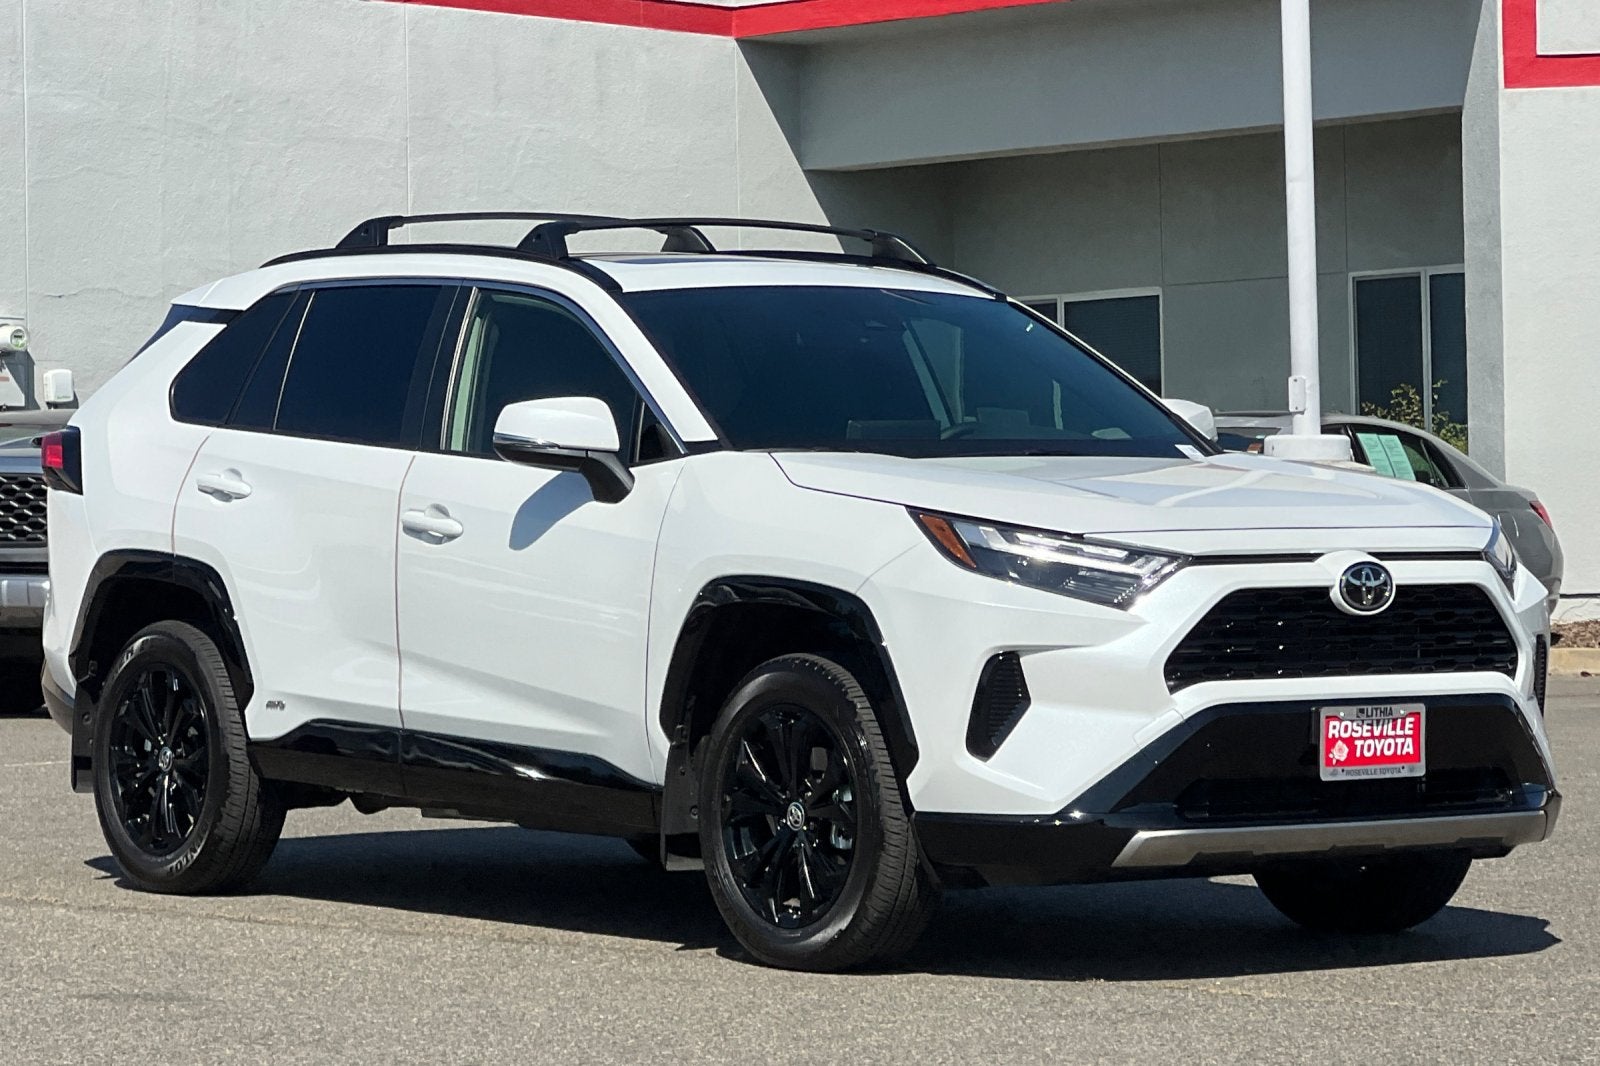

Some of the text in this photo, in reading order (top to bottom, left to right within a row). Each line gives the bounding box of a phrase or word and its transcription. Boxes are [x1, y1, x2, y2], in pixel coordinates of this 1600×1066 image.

[1365, 707, 1394, 718] LITHIA
[1328, 717, 1415, 739] ROSEVILLE
[1354, 737, 1414, 758] TOYOTA
[1345, 767, 1402, 777] ROSEVILLE TOYOTA
